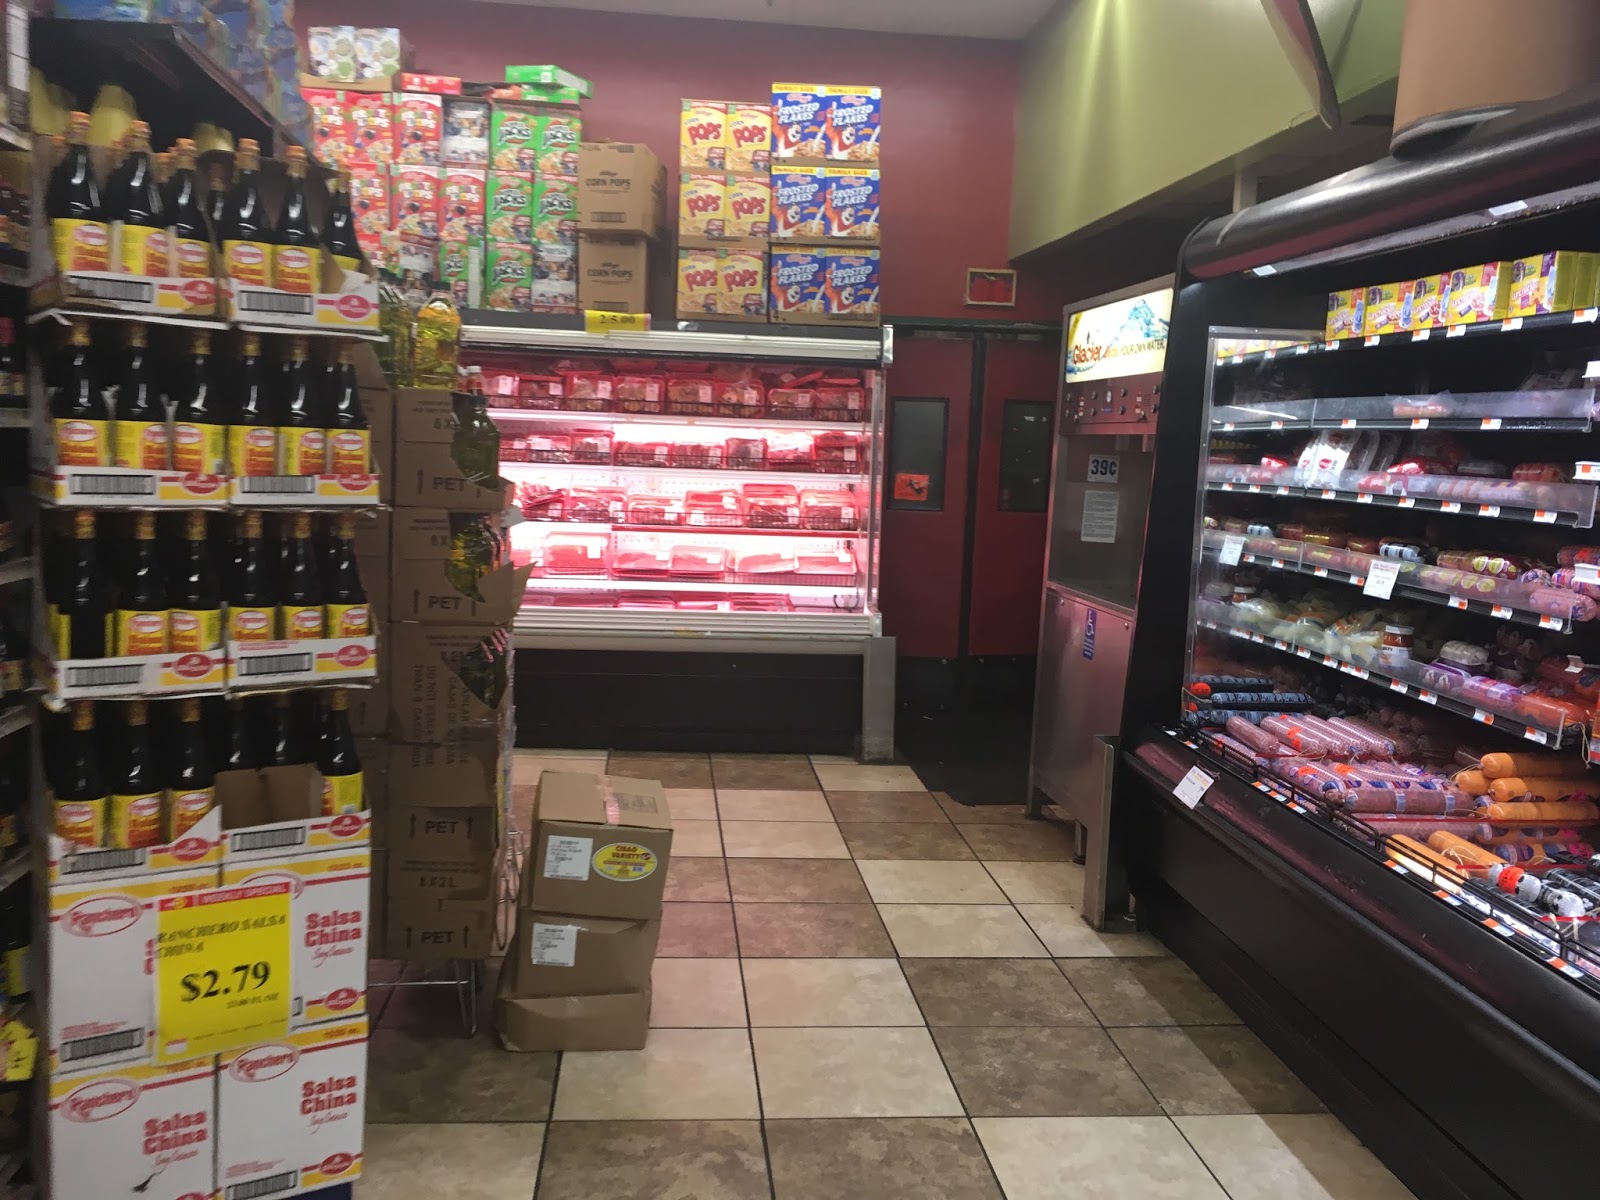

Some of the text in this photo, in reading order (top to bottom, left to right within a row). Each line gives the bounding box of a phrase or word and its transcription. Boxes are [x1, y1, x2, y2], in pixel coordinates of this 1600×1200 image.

[688, 122, 722, 145] POPS
[733, 125, 767, 148] POPS
[585, 178, 631, 187] CORN POPS
[687, 194, 721, 217] POPS
[731, 196, 766, 220] POPS
[587, 269, 633, 278] CORN POPS
[685, 269, 718, 293] POPS
[724, 269, 759, 293] POPS
[1073, 342, 1102, 365] Glacier
[433, 476, 466, 492] PET
[428, 594, 462, 610] PET
[425, 820, 459, 834] PET
[305, 910, 362, 930] Salsa
[304, 926, 362, 948] China
[421, 931, 454, 944] PET
[180, 961, 271, 1003] $2.79
[302, 1075, 357, 1098] Salsa
[300, 1092, 357, 1115] China
[144, 1111, 207, 1137] Salsa
[143, 1128, 208, 1155] China
